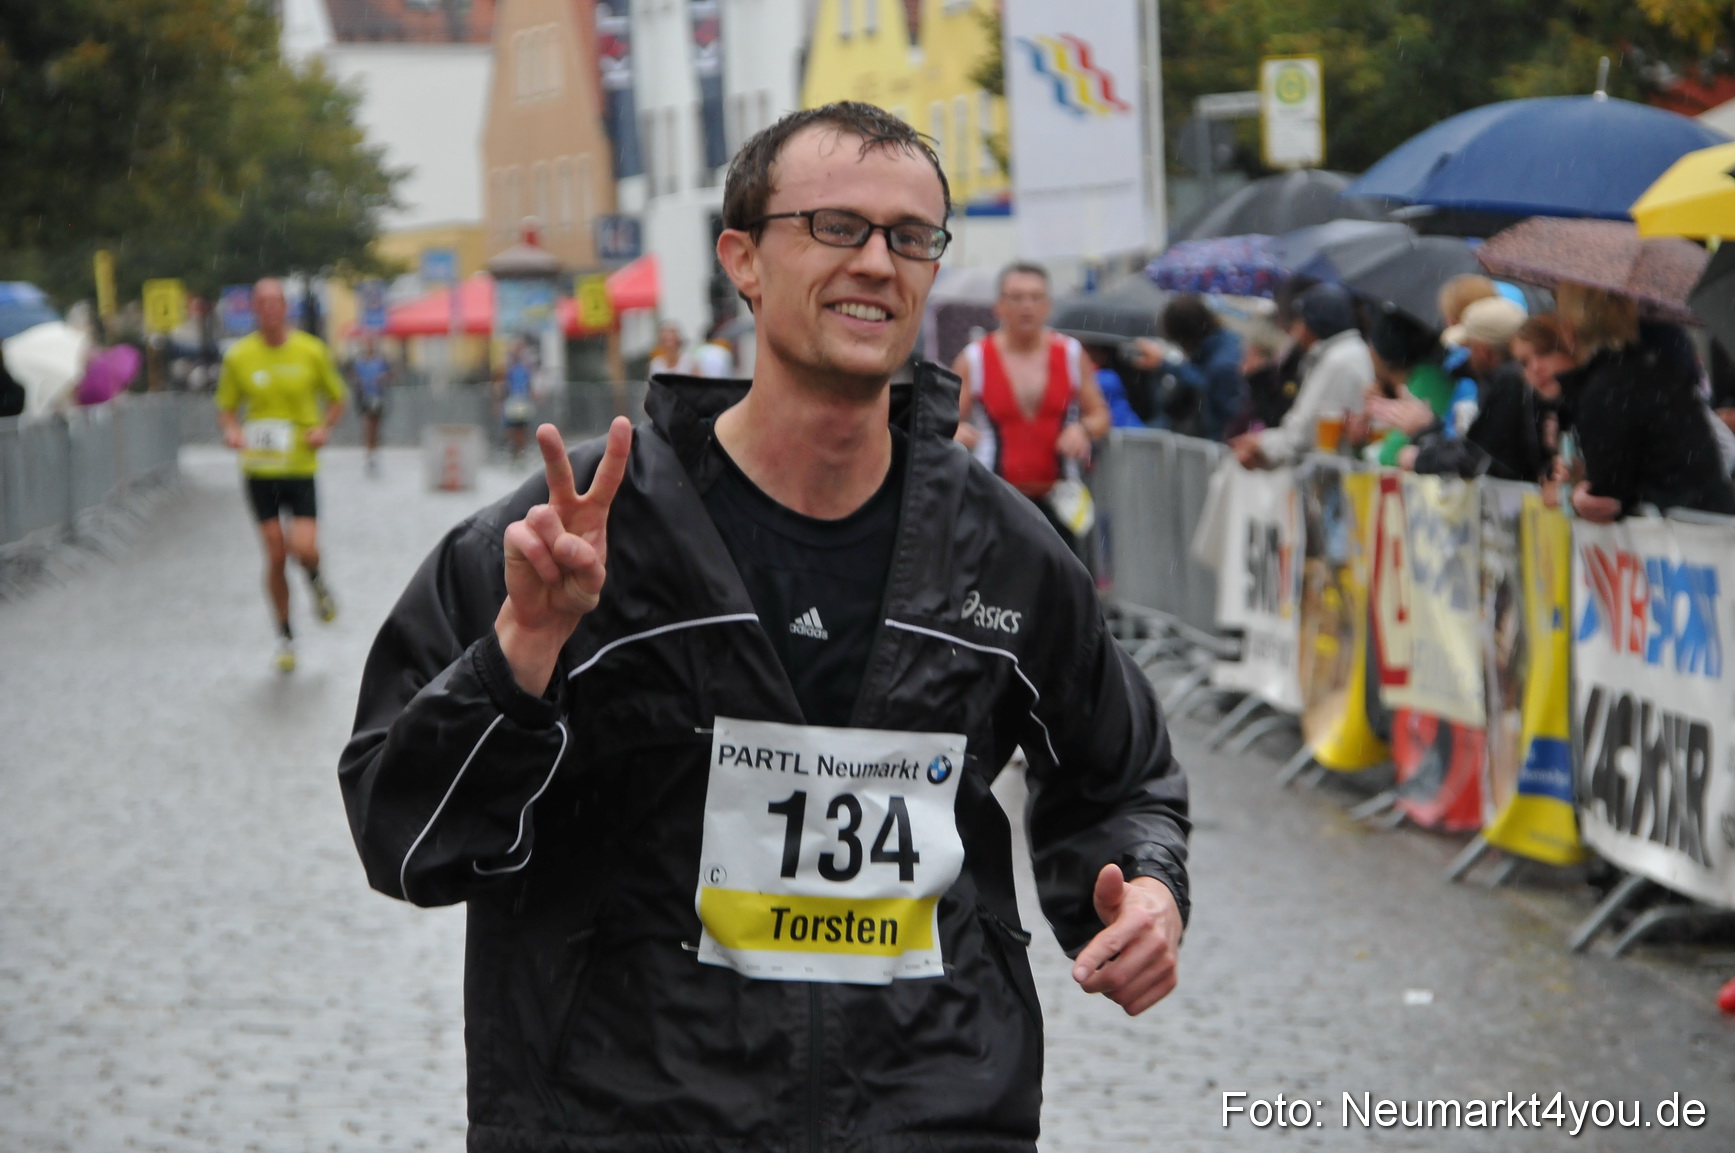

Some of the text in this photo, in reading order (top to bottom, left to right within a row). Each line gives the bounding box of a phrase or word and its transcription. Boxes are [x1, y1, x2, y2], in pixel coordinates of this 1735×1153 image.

[789, 622, 828, 641] adidas
[973, 602, 1022, 634] asics
[718, 743, 919, 781] PARTL Neumarkt
[767, 790, 920, 883] 134
[770, 907, 898, 946] Torsten
